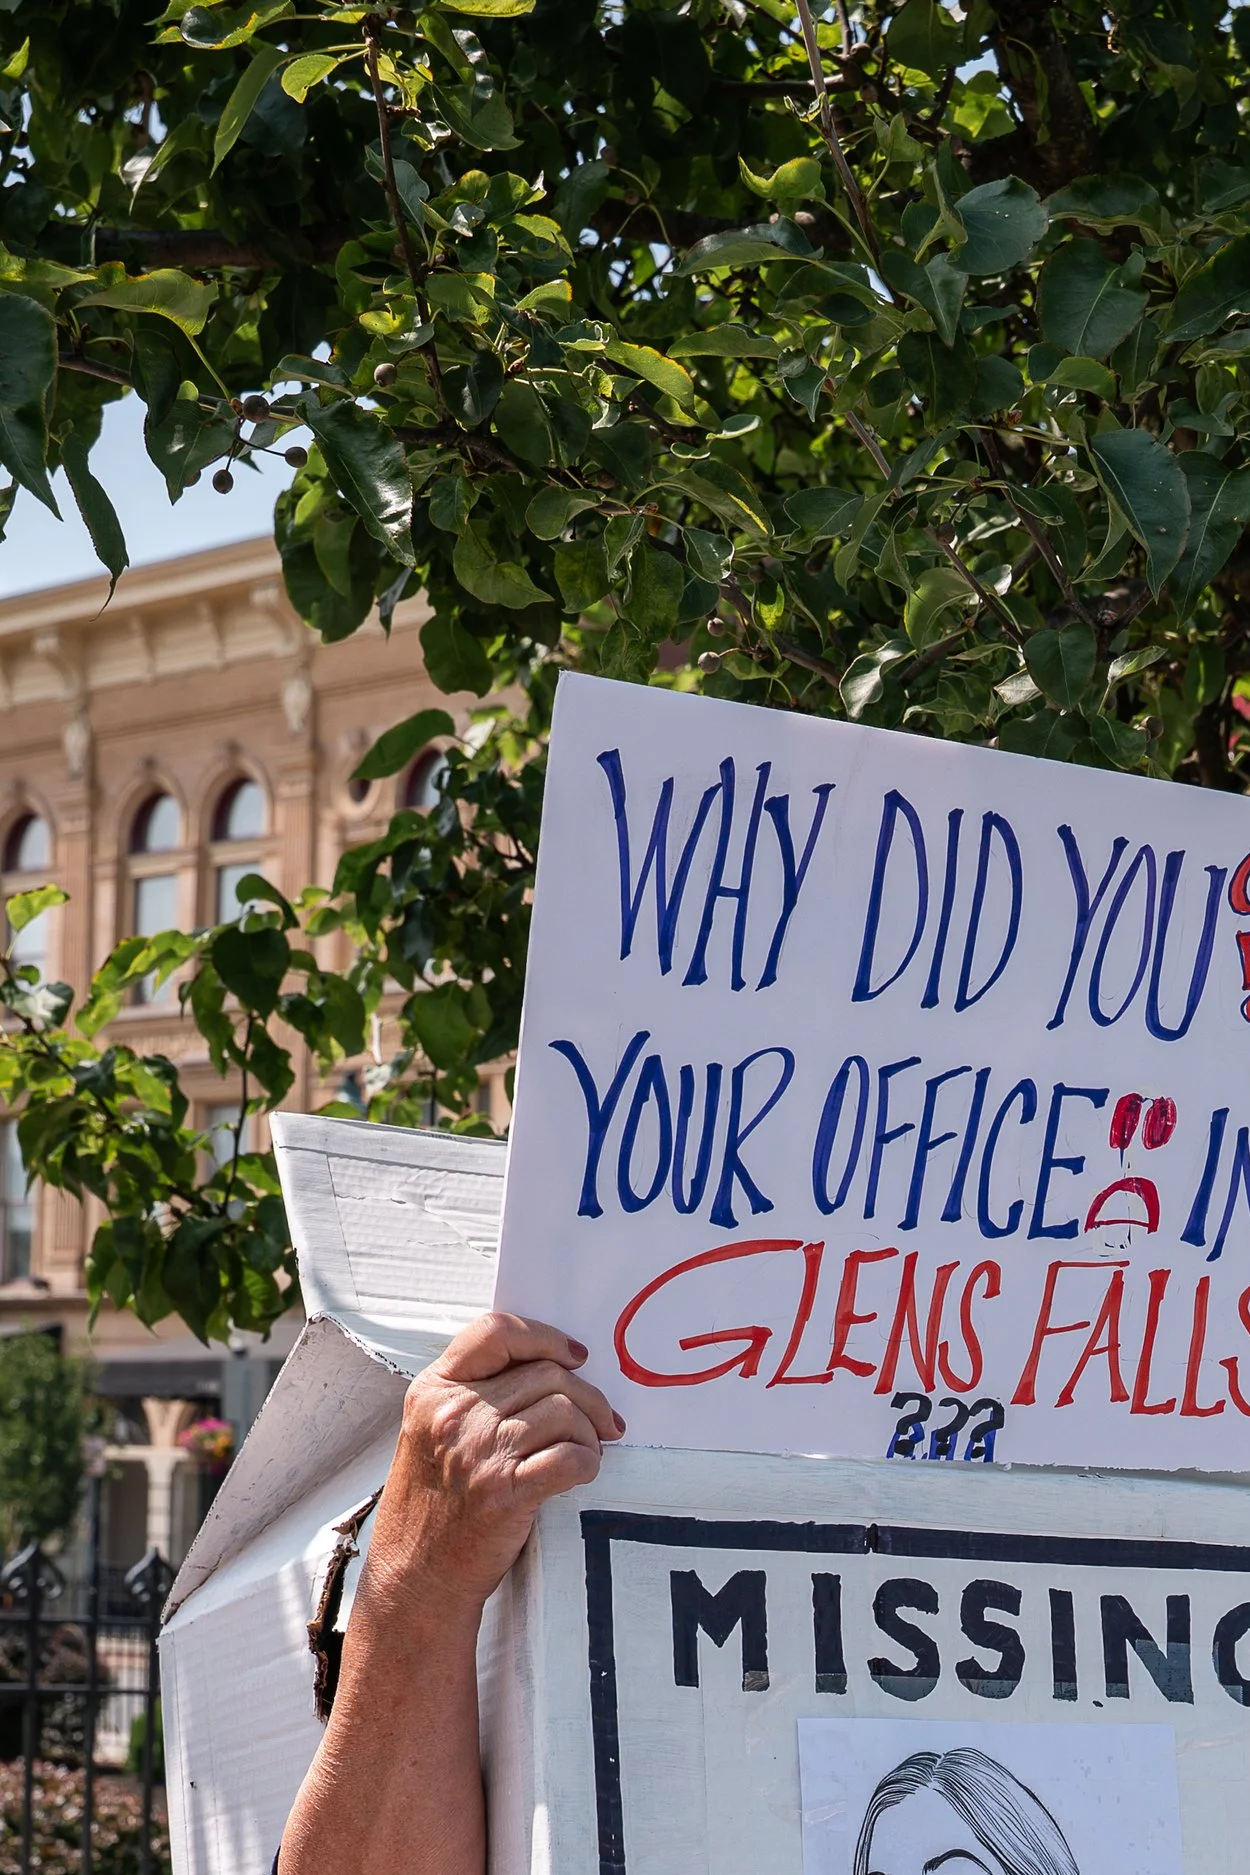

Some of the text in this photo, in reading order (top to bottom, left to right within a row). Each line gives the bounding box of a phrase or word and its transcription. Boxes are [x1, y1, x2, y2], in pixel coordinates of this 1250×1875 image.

[596, 748, 836, 992] WHY
[852, 789, 1023, 1013] DID
[1046, 823, 1230, 1042] YOU
[548, 1030, 796, 1230] YOUR
[812, 1055, 1112, 1241] OFFICE
[613, 1239, 1002, 1396] GLENS
[889, 1392, 1005, 1459] ???
